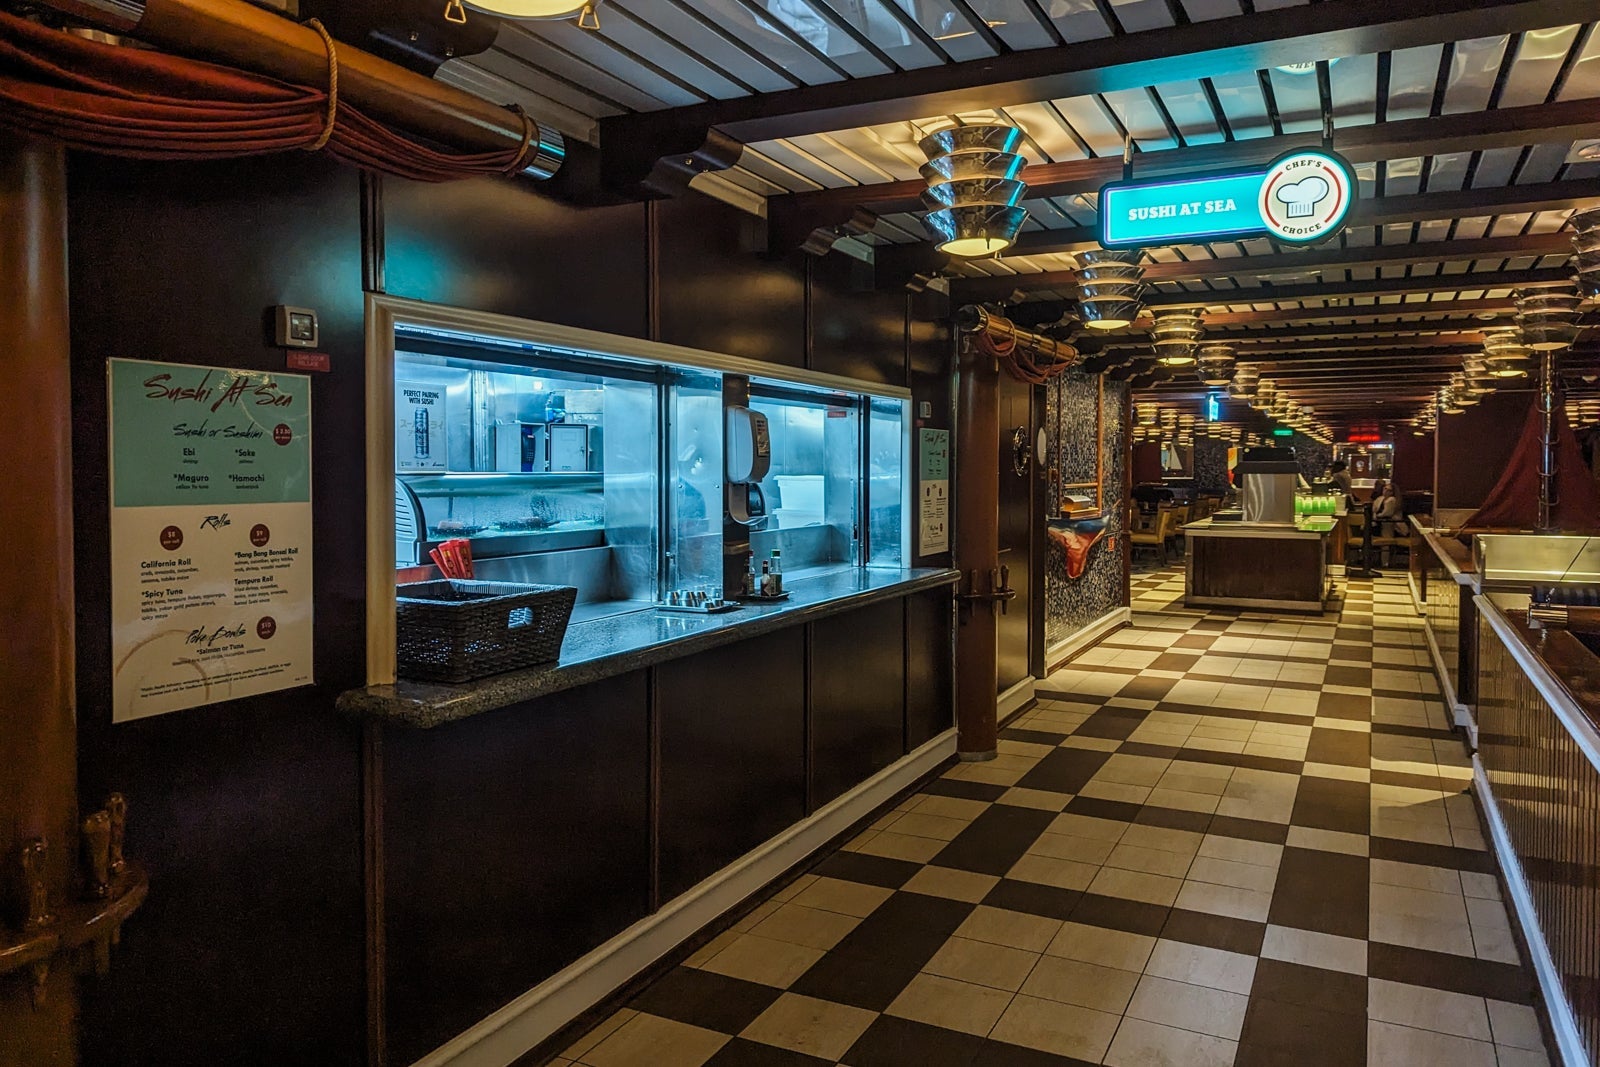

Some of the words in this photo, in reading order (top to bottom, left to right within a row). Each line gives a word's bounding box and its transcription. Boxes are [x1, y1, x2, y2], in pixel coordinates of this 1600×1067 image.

[1286, 160, 1322, 170] CHEF'S
[1128, 204, 1177, 221] SUSHI
[1179, 202, 1202, 216] AT
[1204, 198, 1237, 214] SEA
[1282, 223, 1322, 234] CHOICE
[144, 369, 214, 404] Sushi
[211, 376, 259, 413] At
[254, 382, 293, 407] Sea
[404, 390, 421, 398] PERFECT
[422, 391, 439, 399] PAIRING
[173, 419, 208, 437] Sushi
[208, 429, 222, 438] or
[223, 422, 264, 439] Sashimi
[183, 448, 196, 456] Ebi
[200, 513, 231, 532] Rolls
[140, 559, 176, 569] California
[178, 558, 192, 566] Roll
[186, 625, 207, 645] Poke
[208, 623, 246, 646] Bowls
